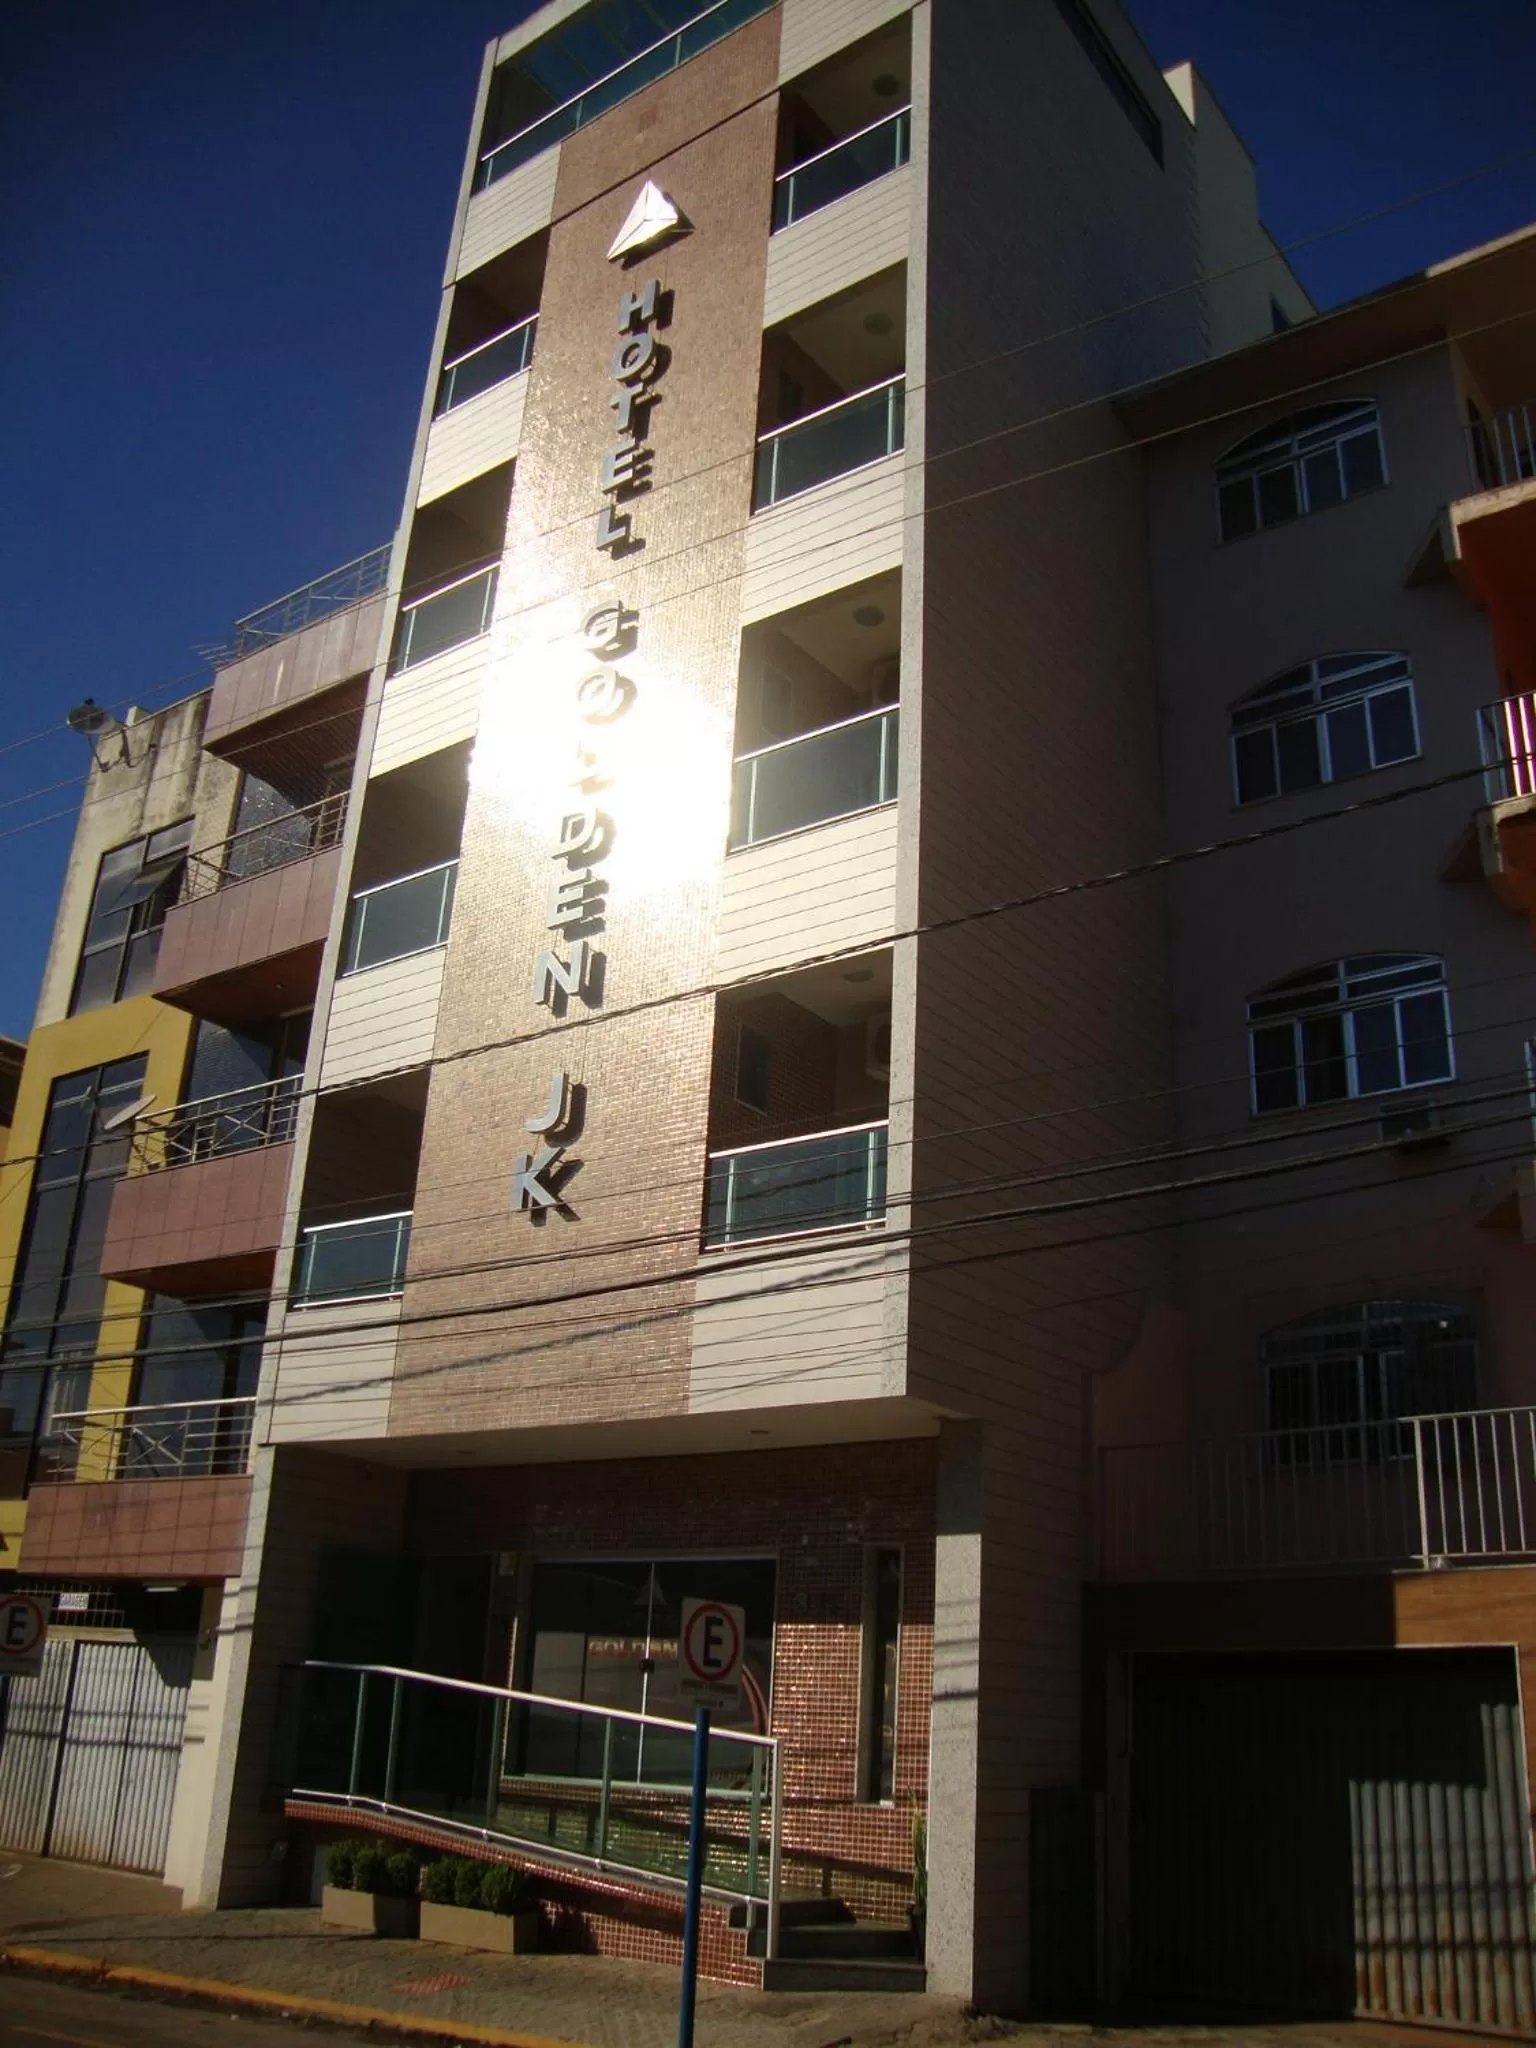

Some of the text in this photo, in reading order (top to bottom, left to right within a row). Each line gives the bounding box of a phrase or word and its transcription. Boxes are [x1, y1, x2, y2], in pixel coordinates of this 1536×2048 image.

[596, 278, 662, 555] HOTEL
[6, 1605, 29, 1645] E
[703, 1616, 723, 1667] E
